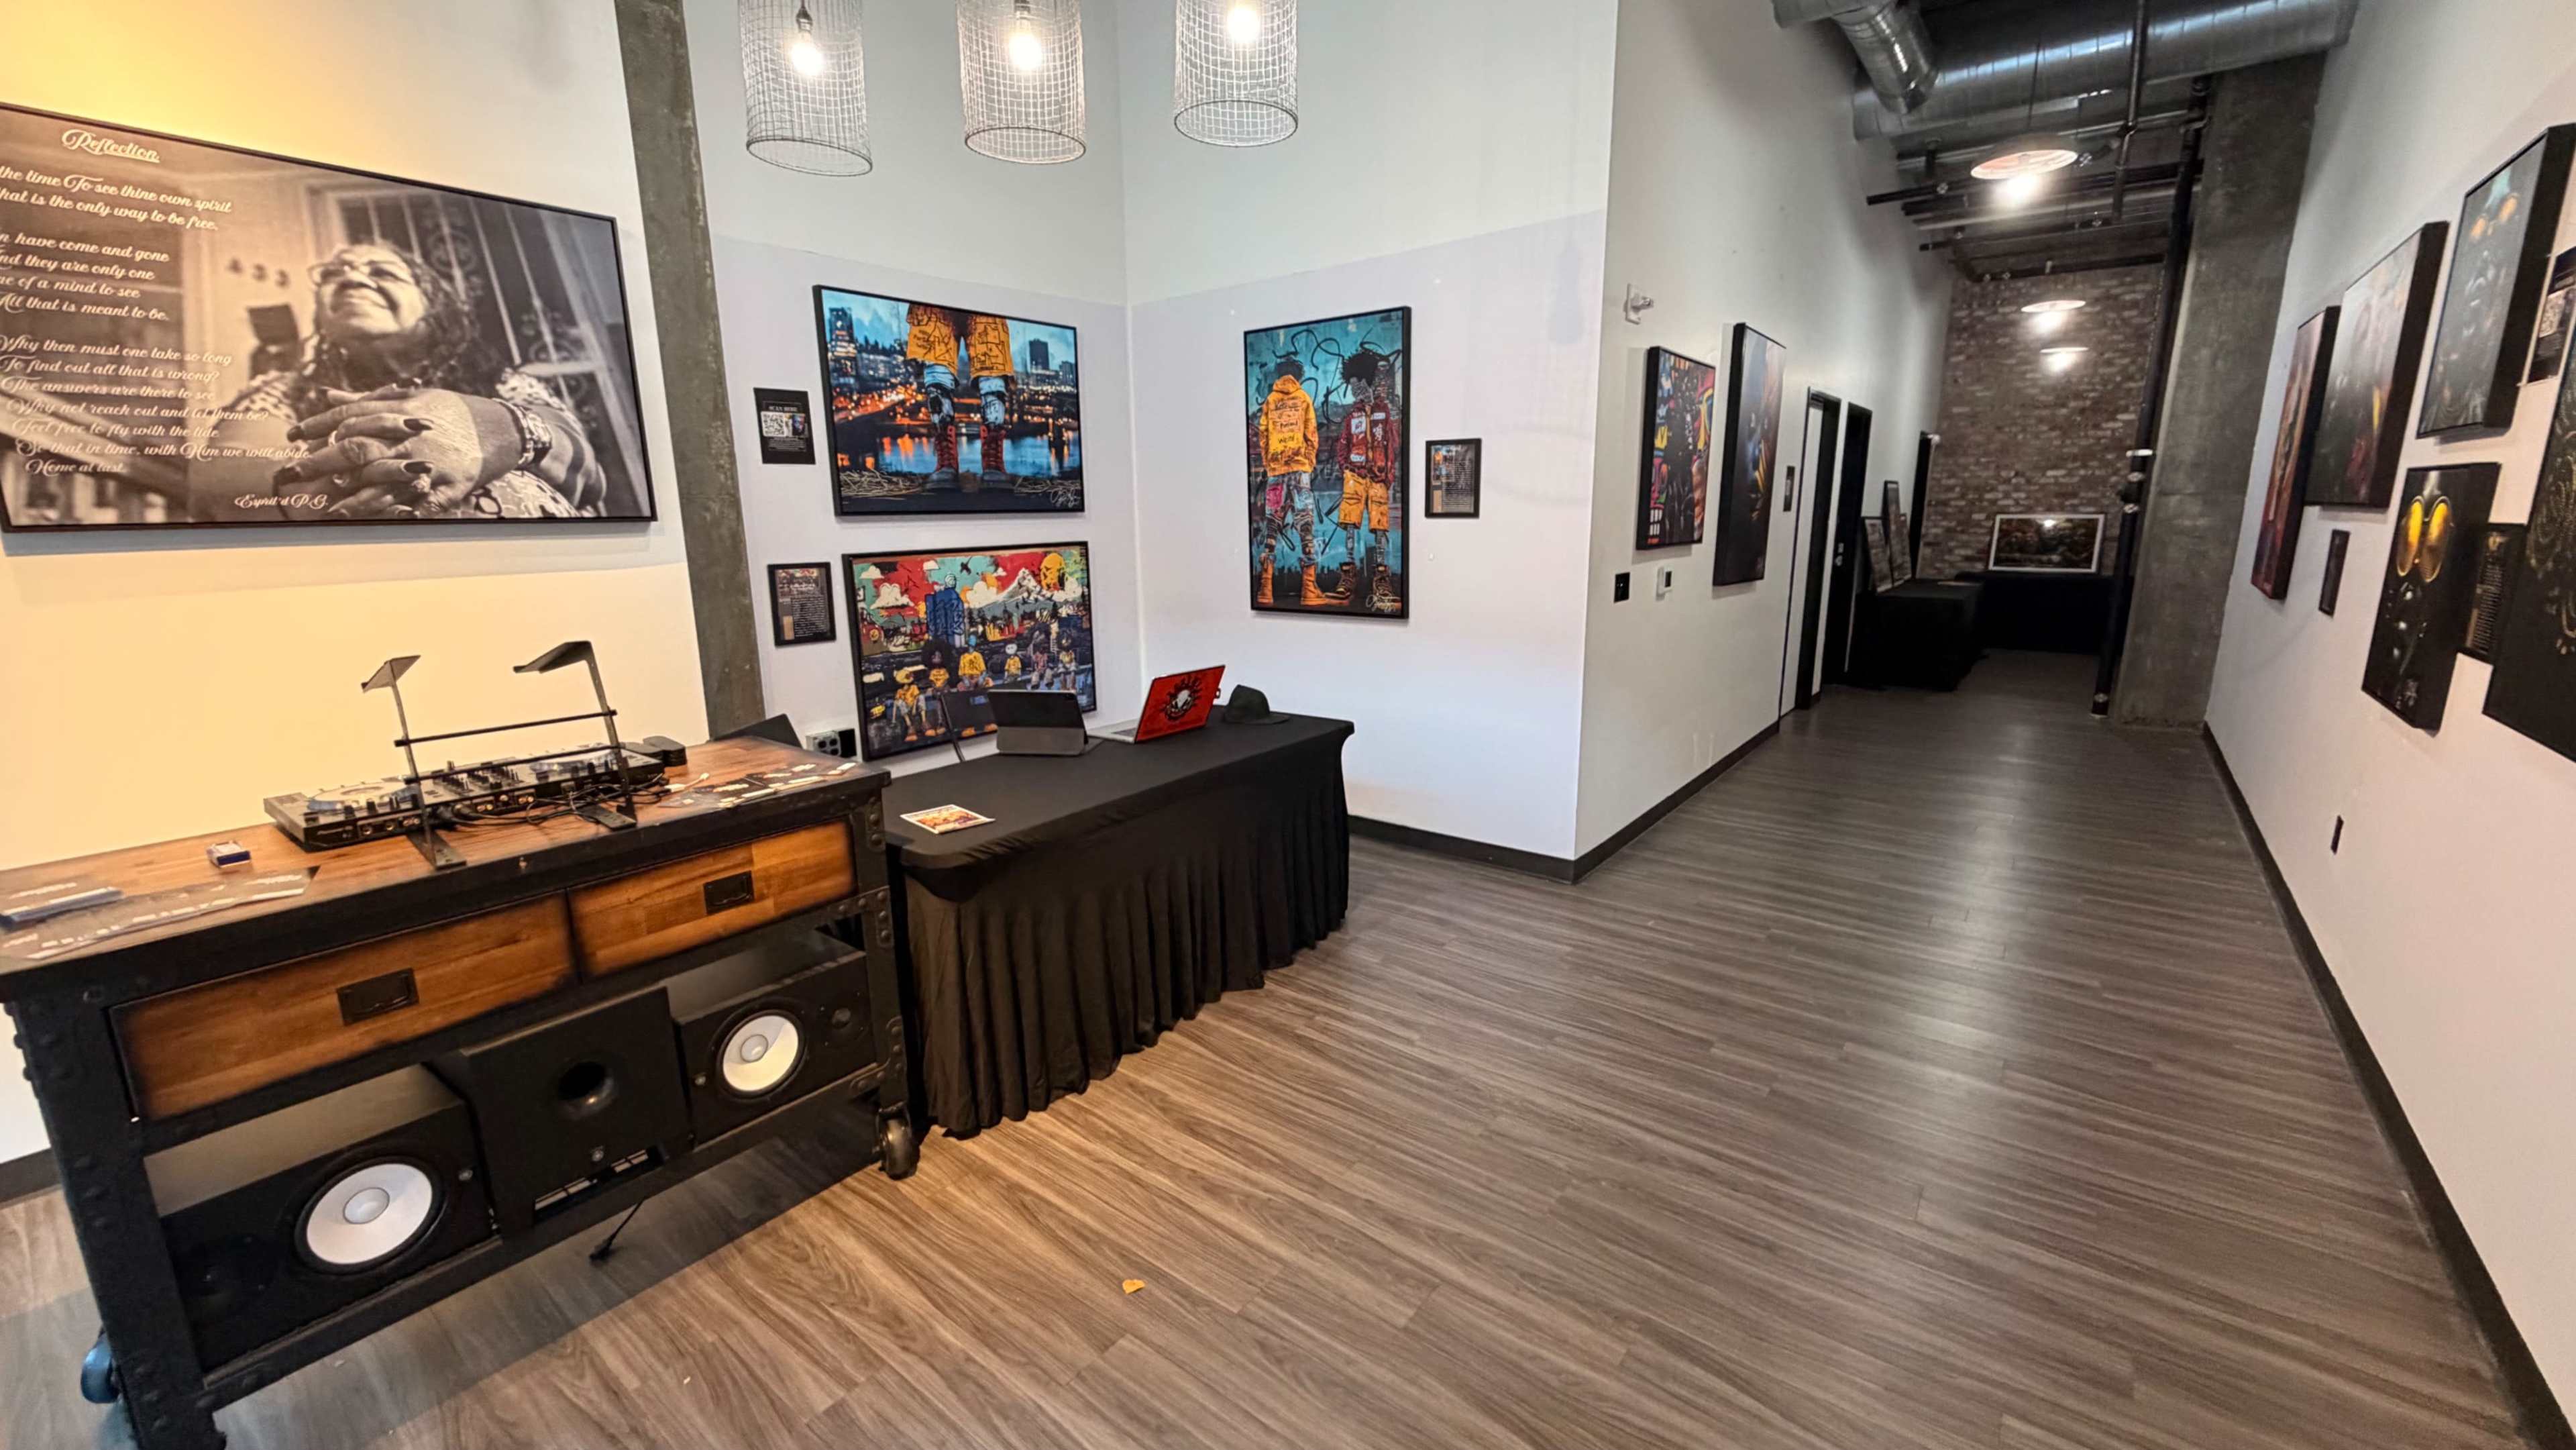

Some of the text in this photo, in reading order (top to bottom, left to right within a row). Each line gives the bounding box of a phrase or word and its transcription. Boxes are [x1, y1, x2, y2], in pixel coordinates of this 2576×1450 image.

[25, 170, 62, 187] time
[64, 174, 103, 193] To
[95, 184, 118, 196] see
[121, 186, 158, 201] thine
[159, 194, 193, 207] own
[195, 197, 232, 213] spirit
[0, 188, 218, 231] hat is the only way to be free.
[15, 232, 57, 248] have
[59, 241, 99, 254] come
[102, 244, 134, 258] and
[136, 250, 170, 262] gone
[0, 254, 155, 280] nd they are only one
[18, 276, 37, 291] of
[37, 280, 51, 289] a
[53, 282, 97, 295] mind
[99, 283, 115, 295] to
[117, 289, 141, 299] see
[26, 297, 59, 310] that
[62, 299, 76, 312] is
[81, 303, 130, 318] meant
[131, 307, 146, 318] to
[148, 307, 170, 321] be.
[43, 340, 76, 353] then
[79, 344, 121, 356] must
[121, 348, 149, 358] one
[151, 347, 182, 360] take
[184, 354, 200, 362] so
[202, 351, 233, 366] long
[27, 360, 62, 373] find
[64, 362, 91, 374] out
[93, 364, 119, 376] all
[117, 365, 150, 378] that
[152, 367, 165, 378] is
[168, 369, 220, 384] wrong?
[1, 376, 215, 401] The answers are there to see
[5, 397, 54, 415] Why
[58, 402, 87, 413] not
[90, 404, 131, 416] reach
[133, 405, 159, 417] out
[159, 406, 189, 418] and
[211, 407, 244, 421] them
[246, 410, 270, 421] be?
[54, 423, 87, 437] free
[89, 423, 105, 434] to
[105, 423, 131, 437] fly
[131, 425, 167, 436] with
[169, 425, 189, 436] the
[15, 439, 44, 457] So
[49, 442, 84, 454] that
[85, 442, 102, 454] in
[103, 442, 141, 456] time,
[144, 444, 176, 456] with
[179, 441, 219, 462] Him
[222, 448, 242, 457] we
[246, 447, 274, 457] will
[24, 458, 77, 477] Home
[78, 462, 95, 472] at
